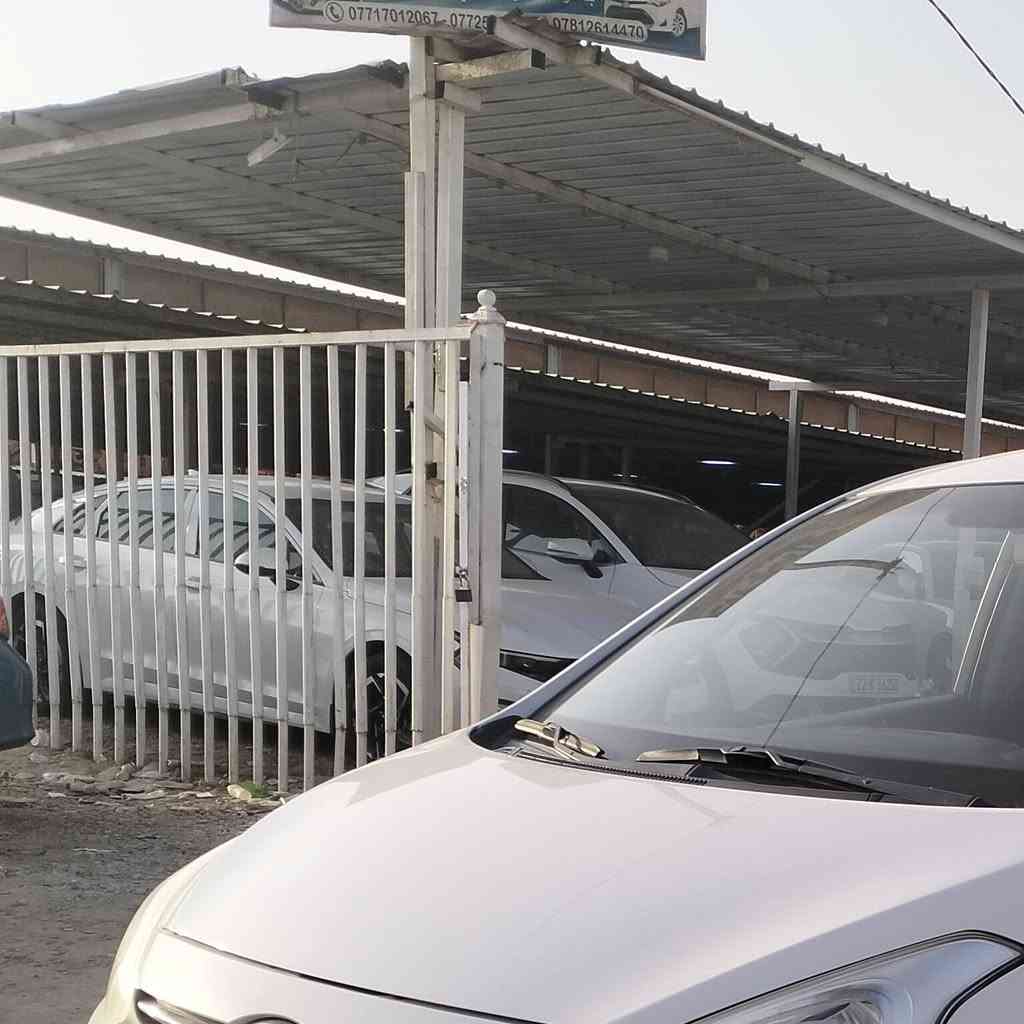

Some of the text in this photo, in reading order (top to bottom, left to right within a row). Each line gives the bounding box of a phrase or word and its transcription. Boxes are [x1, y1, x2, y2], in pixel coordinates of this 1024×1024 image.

[349, 6, 438, 25] 07717012067
[450, 12, 488, 31] 07725
[553, 17, 646, 40] 07812614470
